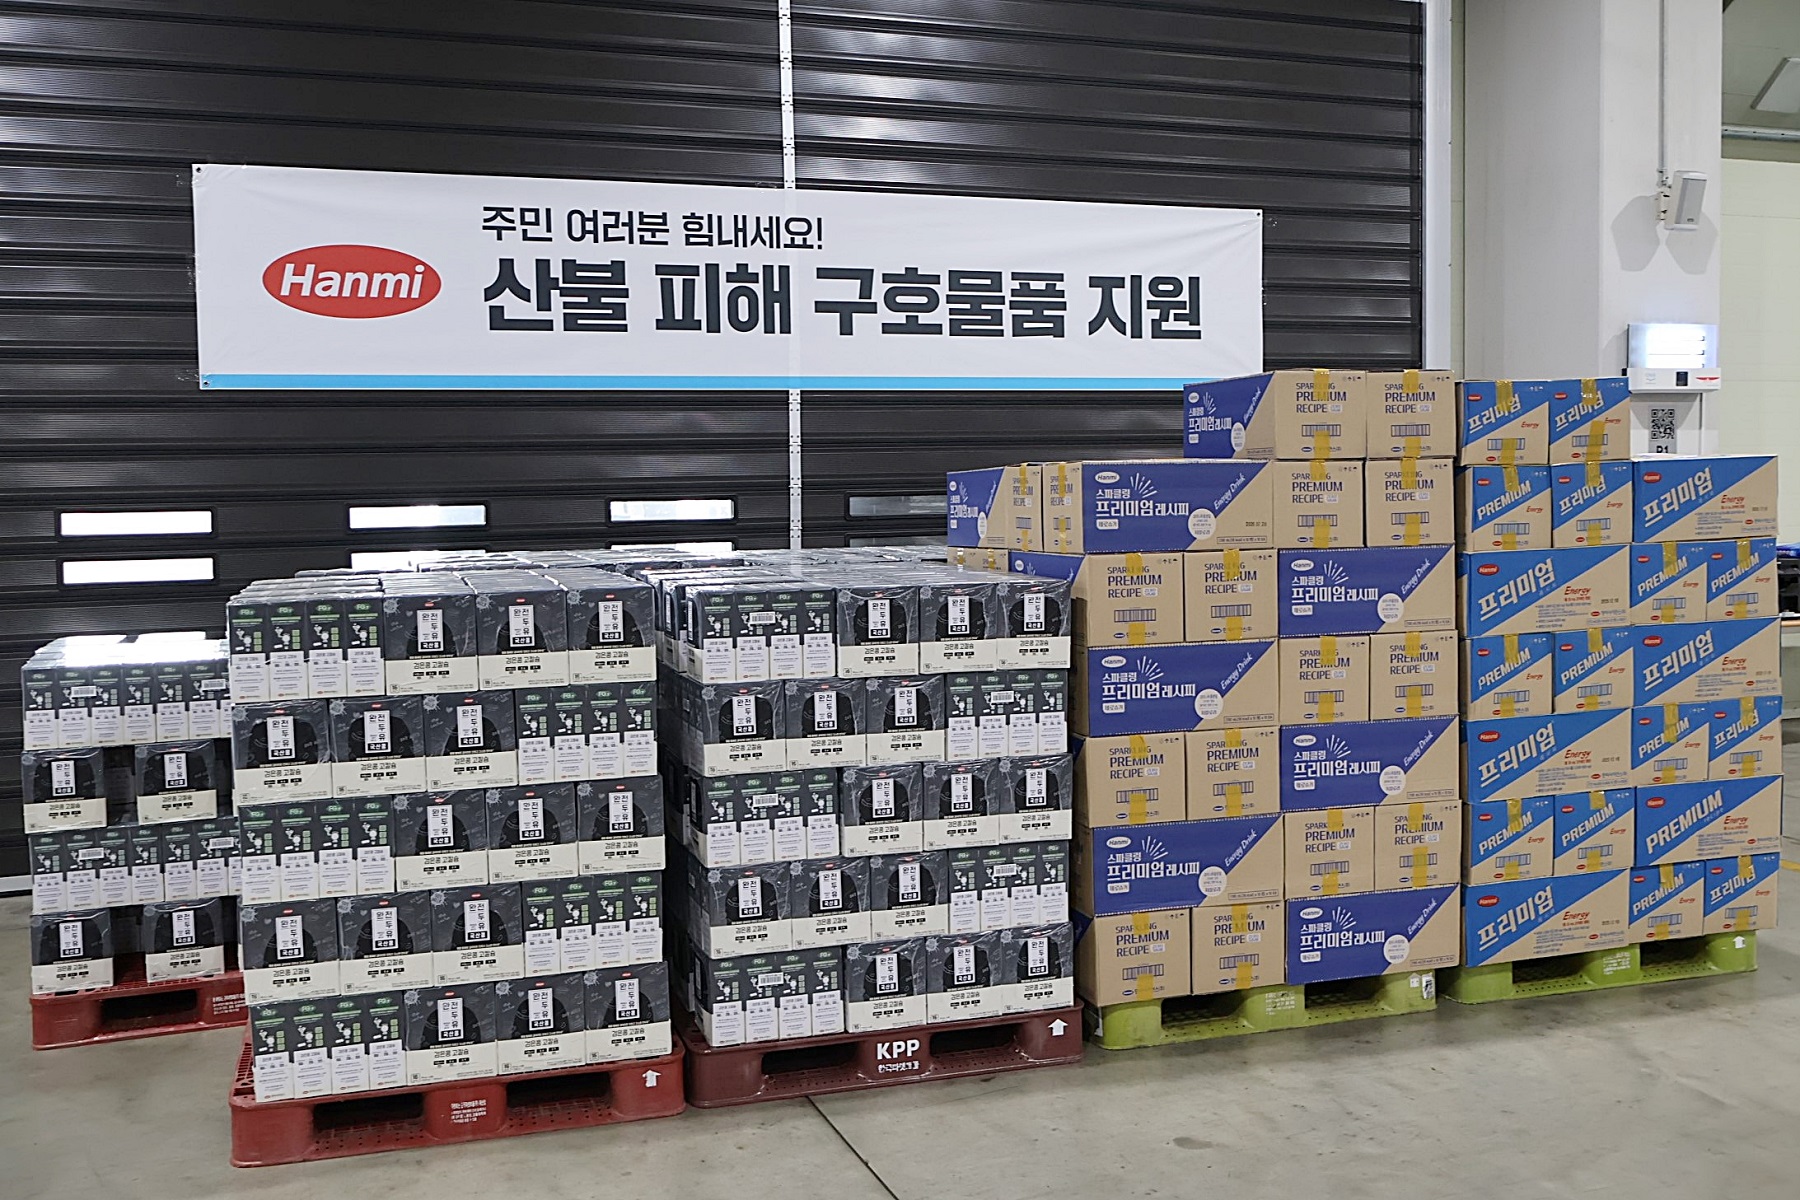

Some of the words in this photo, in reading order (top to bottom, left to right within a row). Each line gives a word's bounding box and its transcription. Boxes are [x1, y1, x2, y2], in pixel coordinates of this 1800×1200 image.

[482, 206, 553, 242] 주민
[567, 208, 670, 246] 여러분
[682, 212, 823, 250] 힘내세요!
[279, 262, 425, 300] Hanmi
[483, 258, 630, 332] 산불
[654, 262, 792, 334] 피해
[814, 266, 1068, 338] 구호물품
[1088, 275, 1202, 340] 지원
[1296, 405, 1327, 413] RECIPE
[1385, 405, 1416, 413] RECIPE
[1292, 482, 1342, 491] PREMIUM
[1292, 494, 1324, 503] RECIPE
[1385, 492, 1416, 501] RECIPE
[1643, 467, 1713, 527] 프리미엄
[1721, 495, 1745, 504] Energy
[1107, 574, 1162, 586] PREMIUM
[1108, 588, 1142, 598] RECIPE
[1205, 584, 1237, 594] RECIPE
[1478, 558, 1555, 621] 프리미엄
[1564, 586, 1591, 596] Energy
[1561, 642, 1613, 685] PREMIUM
[1643, 630, 1714, 691] 프리미엄
[1722, 657, 1747, 666] Energy
[1300, 671, 1331, 680] RECIPE
[1390, 665, 1420, 675] RECIPE
[1207, 748, 1259, 761] PREMIUM
[1478, 723, 1556, 788] 프리미엄
[1564, 750, 1591, 759] Energy
[1110, 754, 1164, 767] PREMIUM
[1208, 761, 1239, 772] RECIPE
[1110, 768, 1143, 779] RECIPE
[1562, 803, 1615, 846] PREMIUM
[1645, 790, 1723, 854] PREMIUM
[1724, 816, 1748, 825] Energy
[1305, 828, 1355, 842] PREMIUM
[1395, 835, 1425, 845] RECIPE
[1306, 843, 1336, 853] RECIPE
[1478, 886, 1554, 951] 프리미엄
[1562, 911, 1590, 921] Energy
[1116, 930, 1169, 945] PREMIUM
[1214, 934, 1245, 946] RECIPE
[1117, 945, 1149, 957] RECIPE
[877, 1039, 920, 1060] KPP
